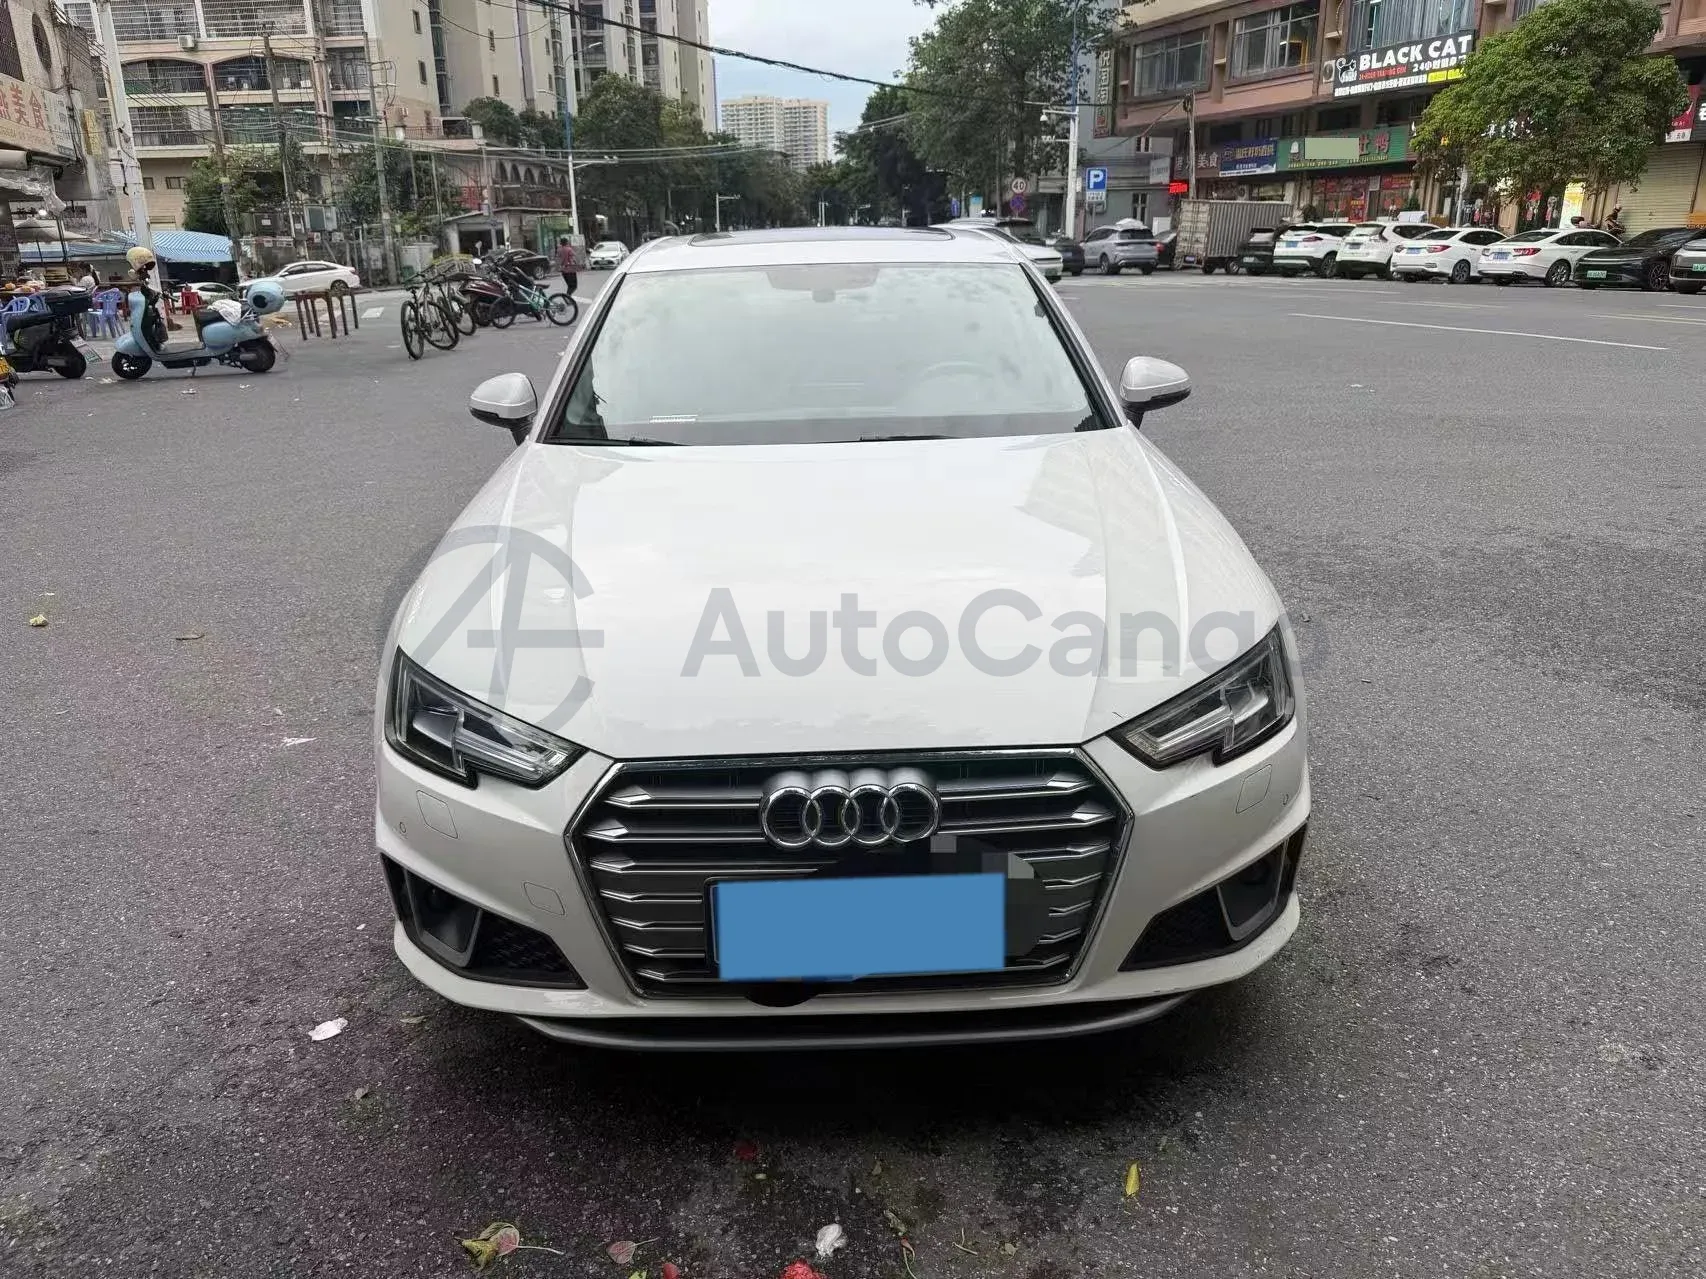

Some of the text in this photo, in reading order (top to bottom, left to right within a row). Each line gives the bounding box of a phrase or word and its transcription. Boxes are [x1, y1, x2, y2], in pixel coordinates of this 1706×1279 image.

[1359, 35, 1472, 71] BLACK CAT
[1013, 180, 1025, 190] 40
[1089, 170, 1104, 189] P
